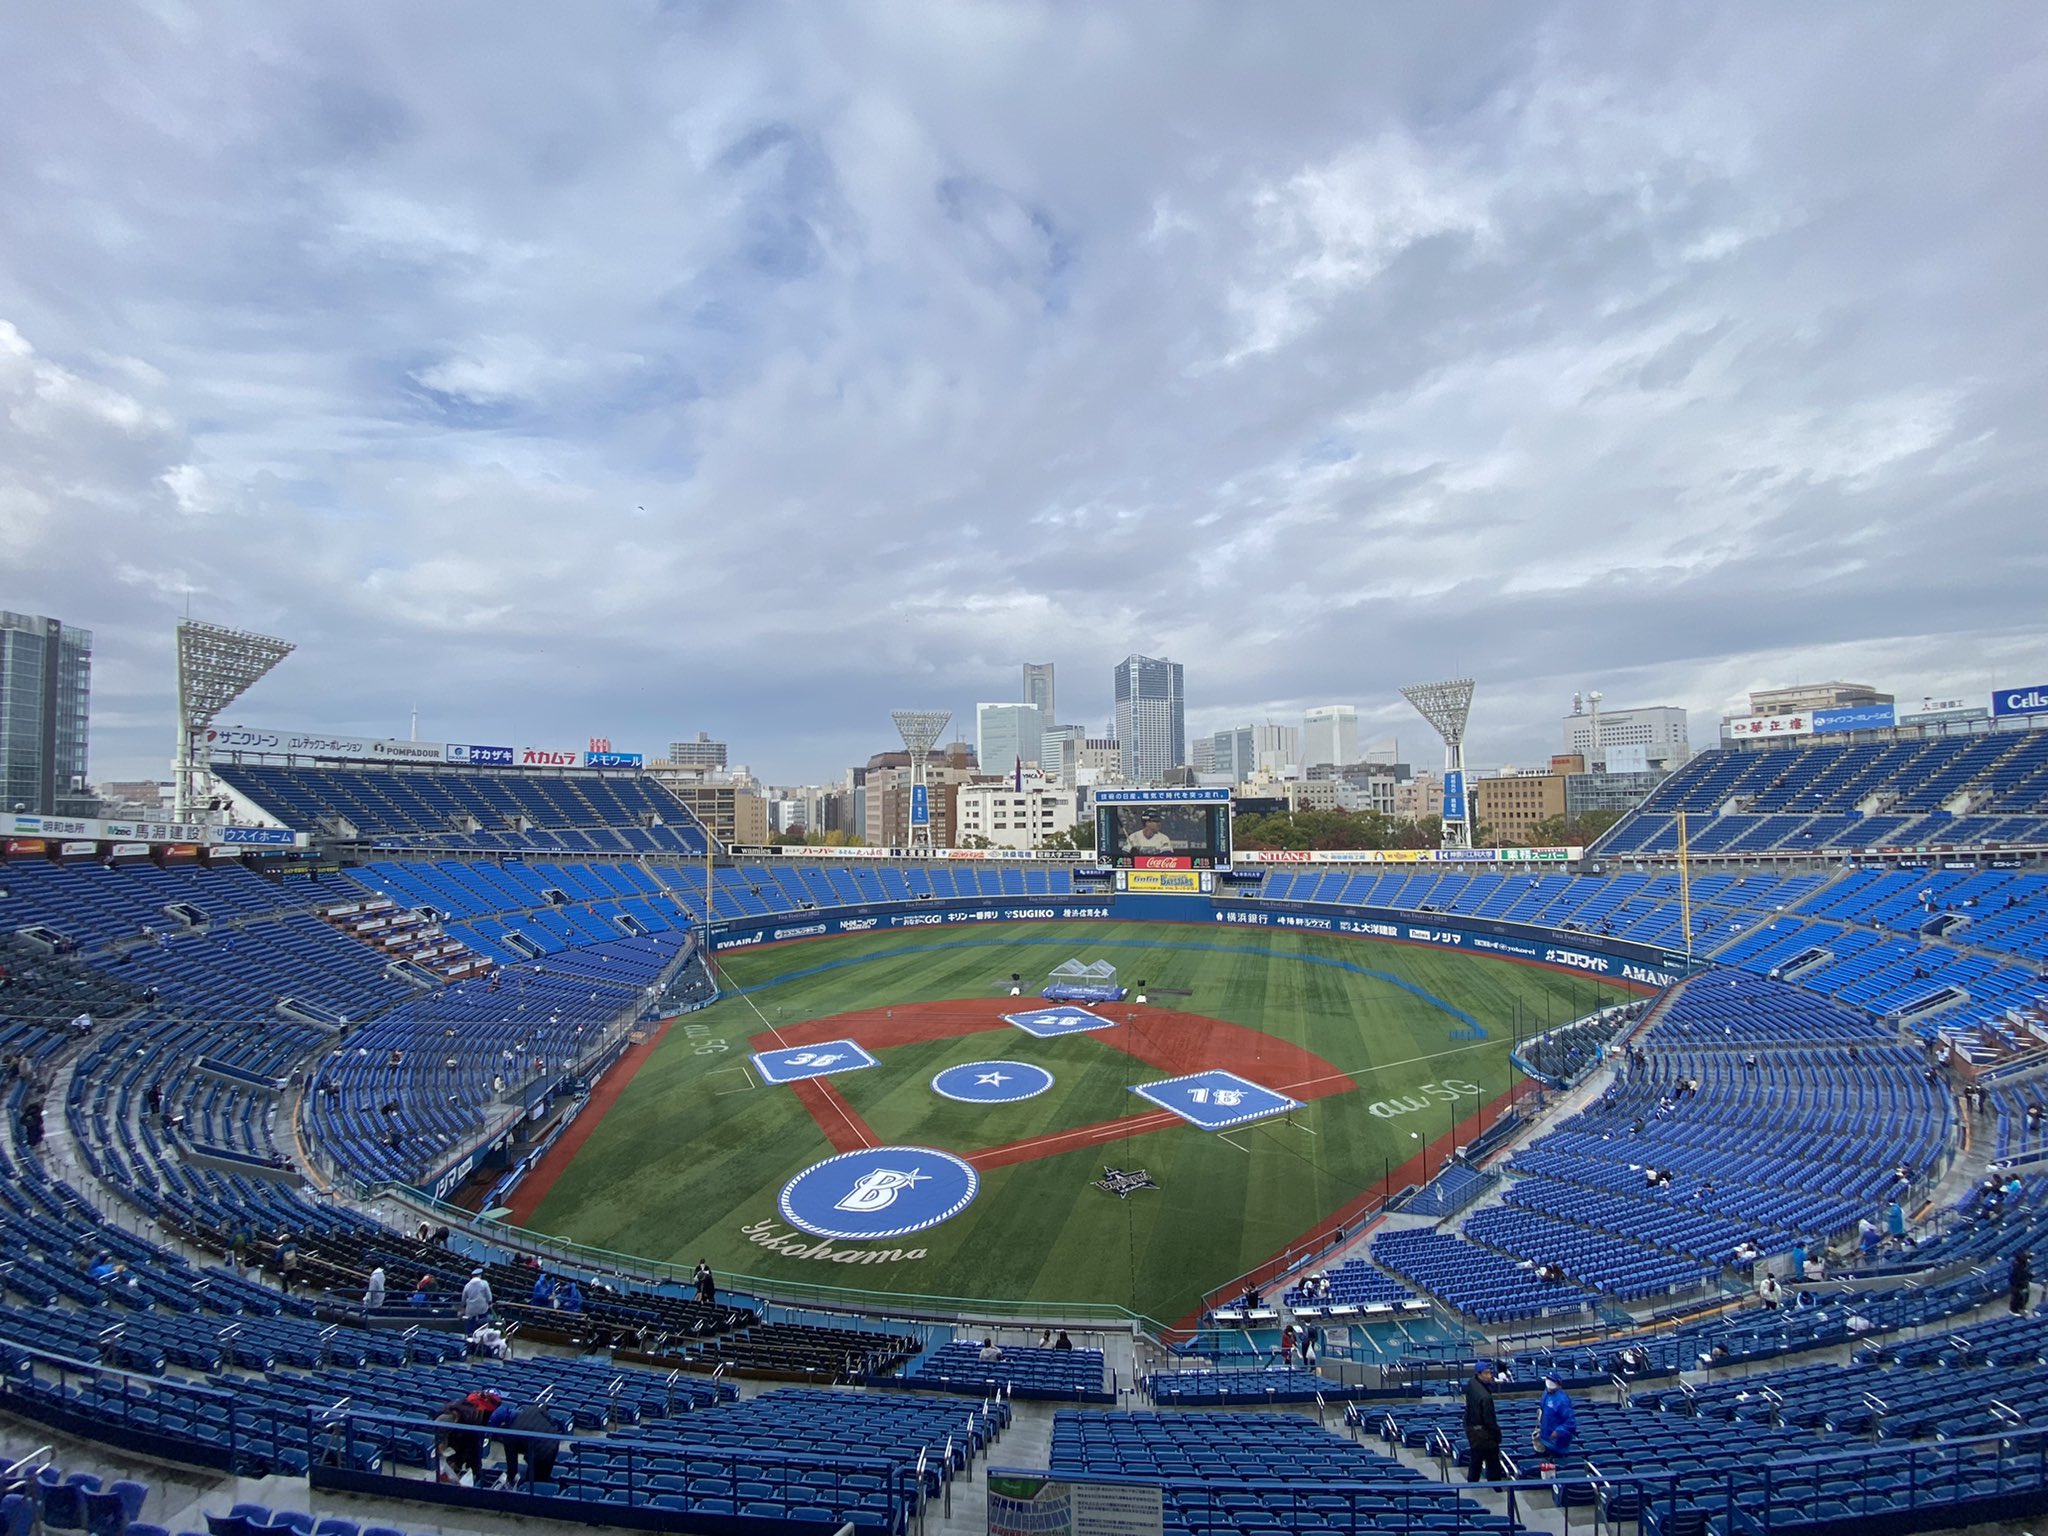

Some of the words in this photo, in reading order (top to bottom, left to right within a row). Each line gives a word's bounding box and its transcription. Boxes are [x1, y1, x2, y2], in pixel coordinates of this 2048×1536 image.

[219, 730, 279, 747] サニクリーン
[386, 746, 440, 759] POMPADOUR
[471, 748, 512, 761] オカザキ
[523, 751, 576, 765] オカムラ
[588, 755, 642, 767] メモワール
[42, 821, 86, 834] 明和地所
[225, 830, 291, 843] ウスイホーム
[1012, 909, 1054, 918] SUGIKO
[1226, 911, 1268, 925] 横浜銀行
[1361, 924, 1398, 937] 大洋建設
[1432, 932, 1462, 945] ノジマ
[1556, 950, 1608, 971] コロワイド
[1425, 1077, 1483, 1102] 5G
[741, 1218, 928, 1265] Yokohama
